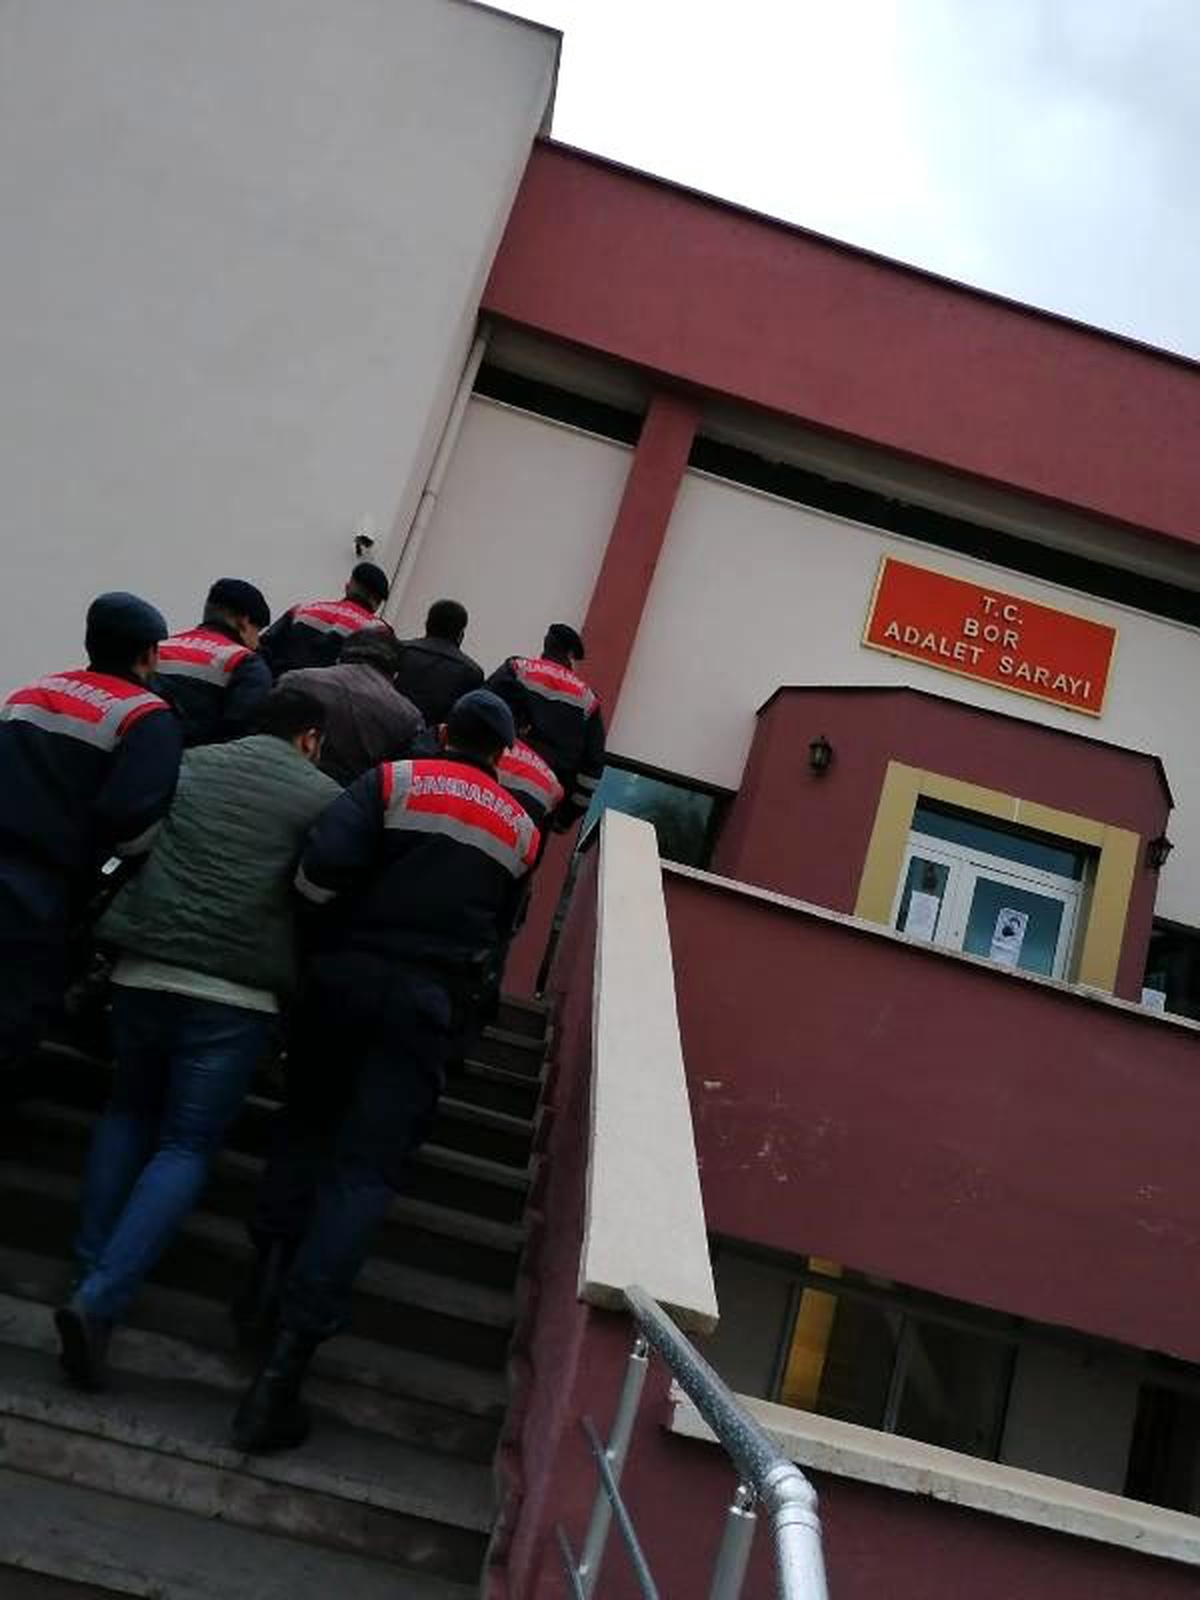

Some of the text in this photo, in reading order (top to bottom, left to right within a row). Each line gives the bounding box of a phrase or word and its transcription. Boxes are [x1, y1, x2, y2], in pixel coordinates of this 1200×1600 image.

[983, 596, 1024, 625] T.C.
[964, 618, 1019, 650] BOR
[884, 621, 1092, 698] ADALET SARAYI
